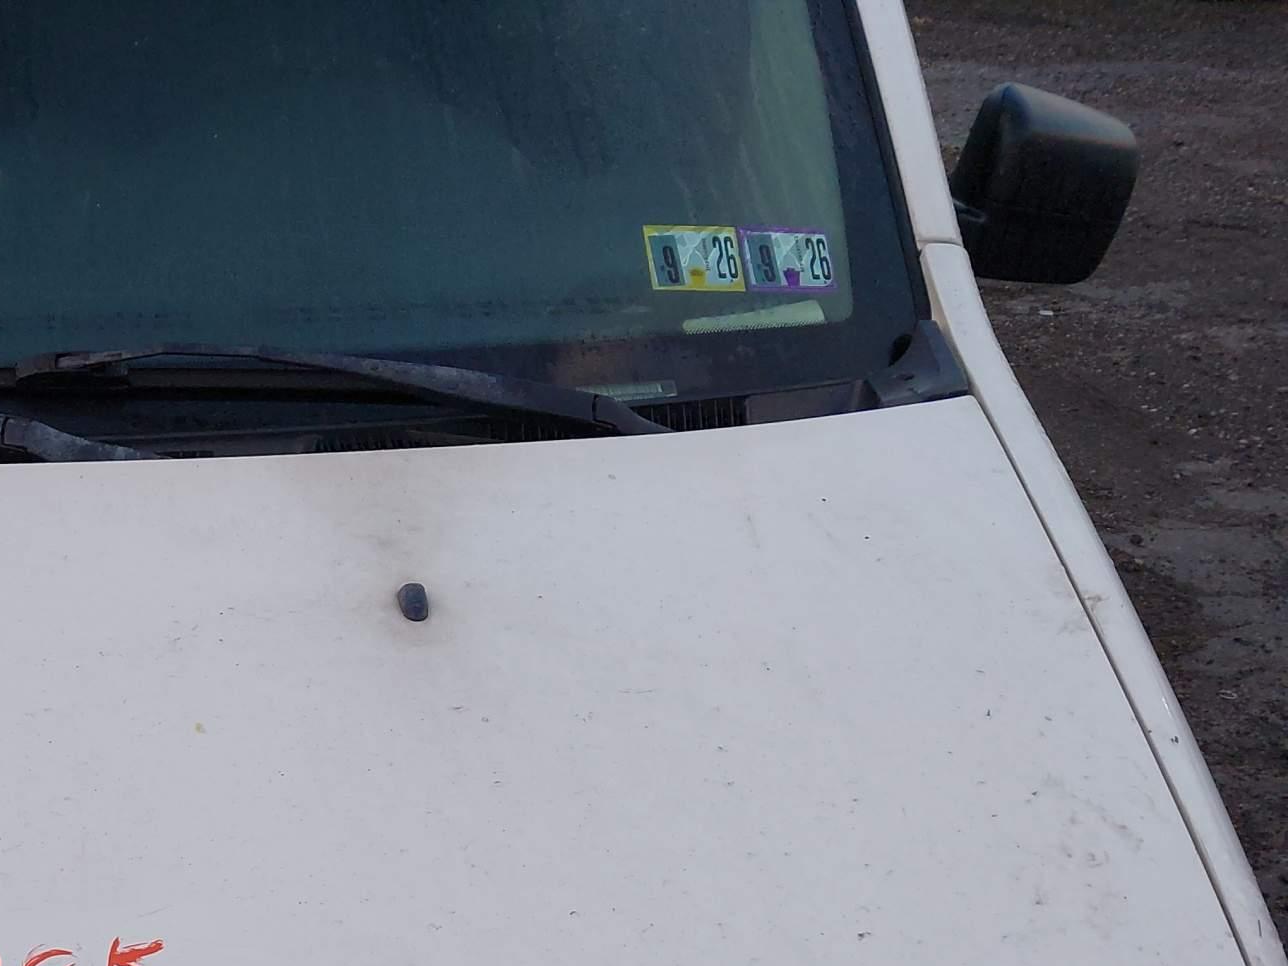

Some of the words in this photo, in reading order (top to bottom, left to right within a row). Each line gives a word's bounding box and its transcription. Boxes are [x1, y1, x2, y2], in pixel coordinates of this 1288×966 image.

[662, 245, 680, 284] 9
[712, 235, 739, 280] 26
[759, 243, 777, 283] 9
[805, 237, 832, 281] 26
